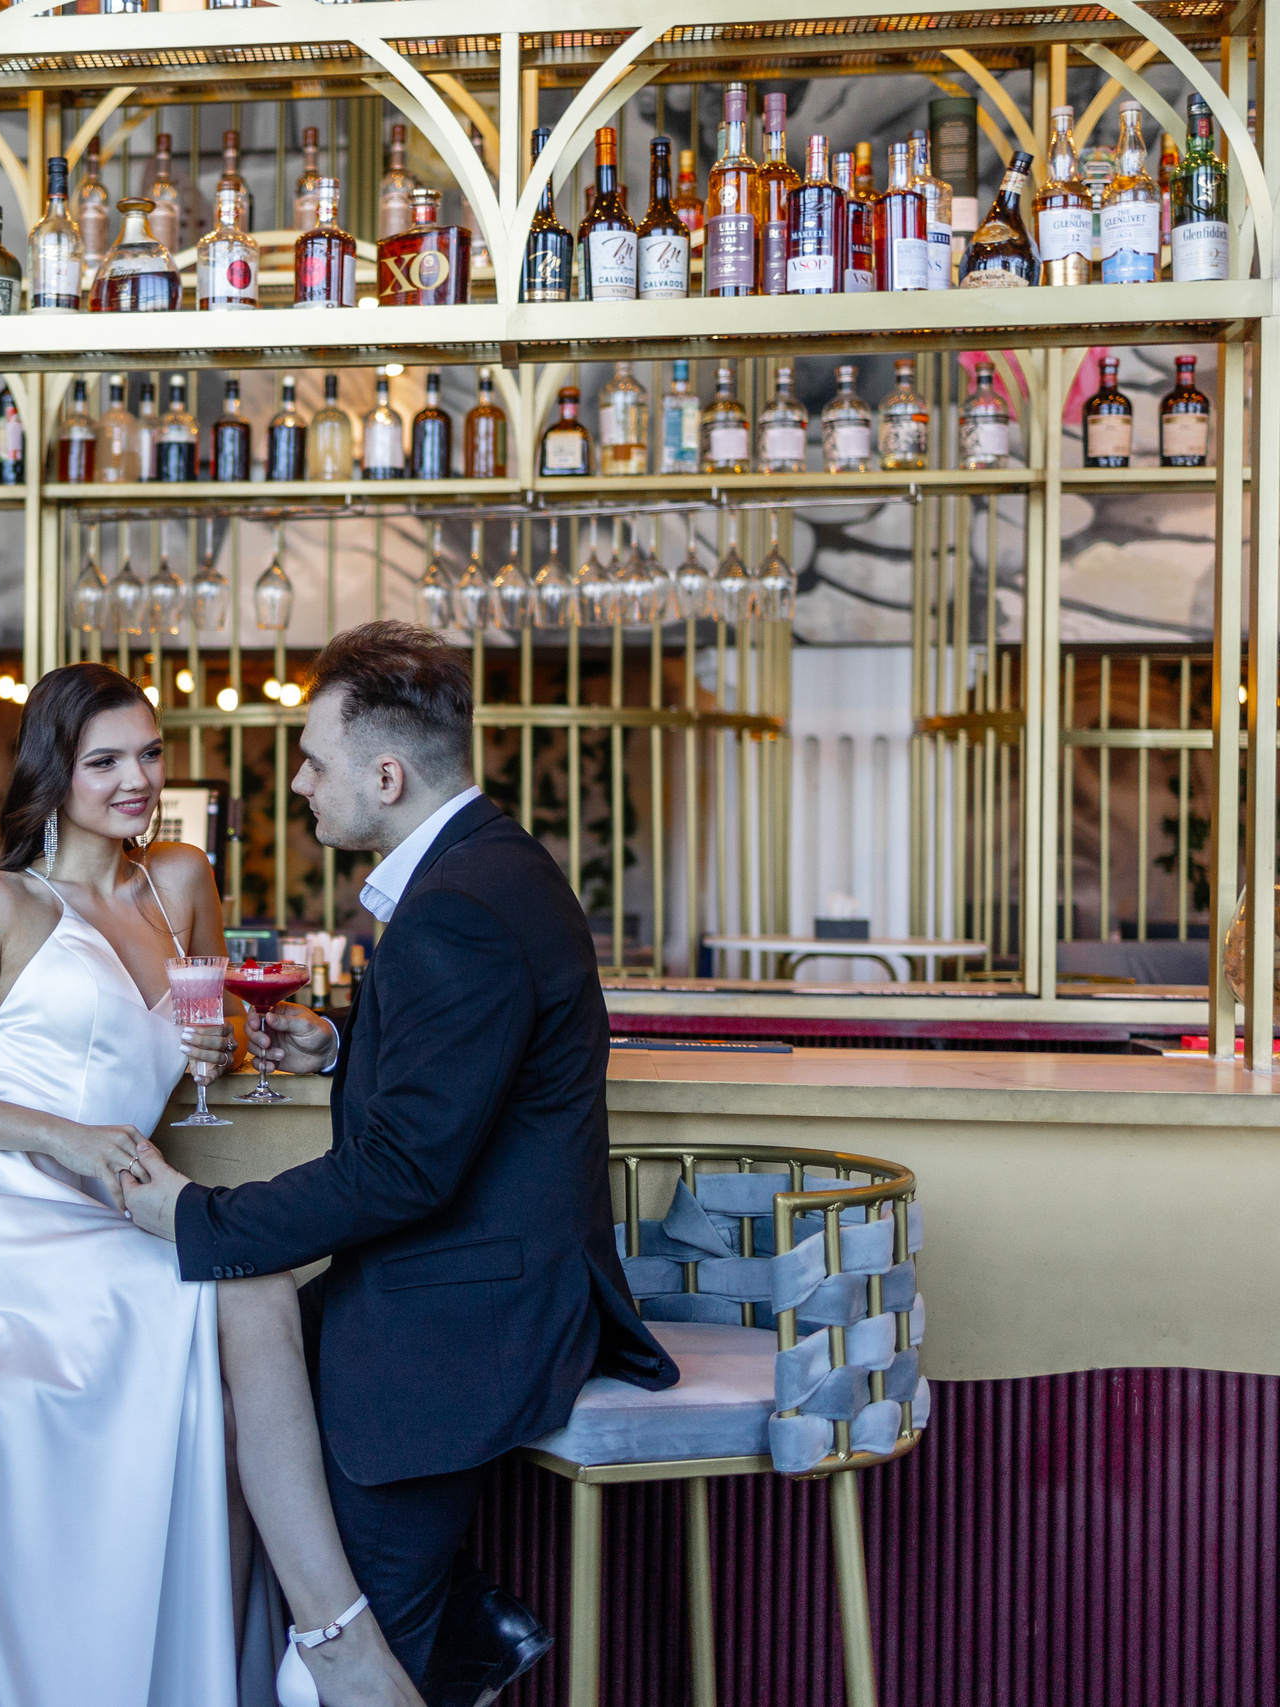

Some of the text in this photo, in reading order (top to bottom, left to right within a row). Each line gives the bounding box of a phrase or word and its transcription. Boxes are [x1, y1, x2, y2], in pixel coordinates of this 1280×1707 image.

[1104, 214, 1147, 227] GLENLIVET
[791, 230, 828, 239] MARTELL
[927, 233, 949, 244] RTELL
[792, 259, 827, 271] VSOP
[380, 250, 450, 297] XO
[643, 280, 684, 289] CALVADOS
